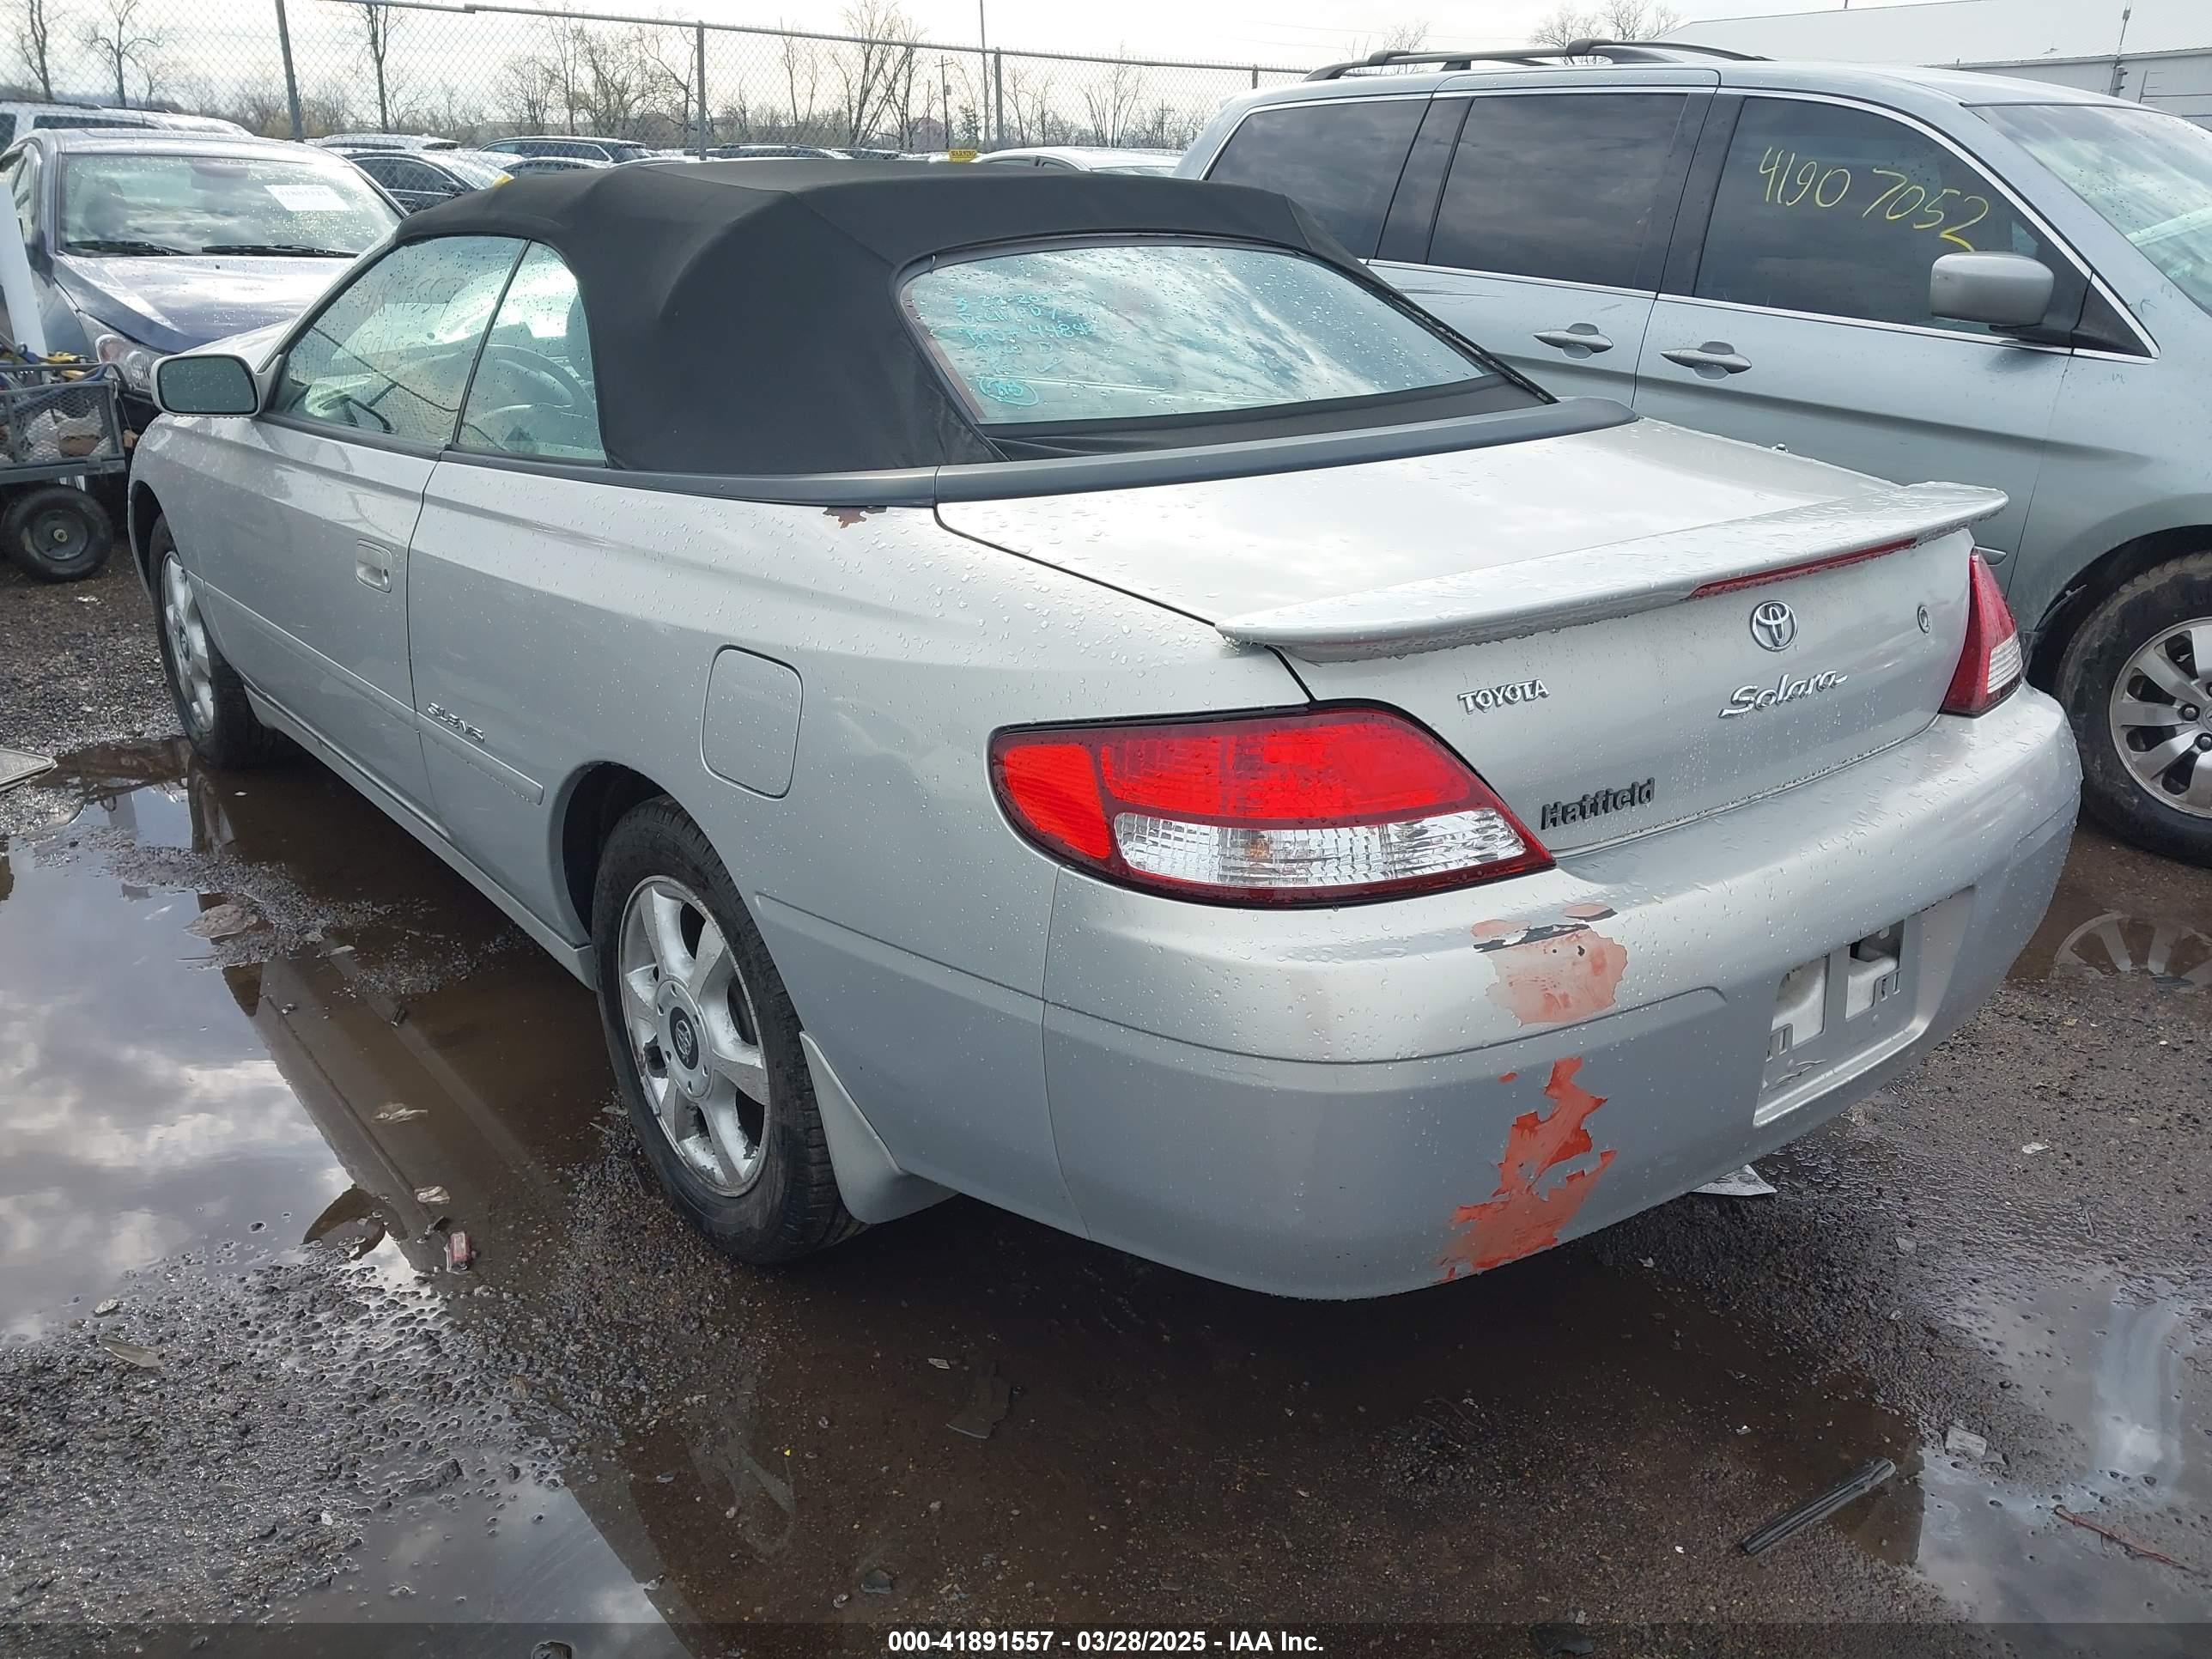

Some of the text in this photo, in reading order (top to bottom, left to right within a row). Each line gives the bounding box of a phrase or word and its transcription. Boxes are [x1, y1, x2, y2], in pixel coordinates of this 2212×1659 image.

[1759, 146, 1990, 253] 4190 7052
[1458, 678, 1549, 714] TOYOTA
[1718, 669, 1848, 718] Solara
[1540, 777, 1656, 830] Hatfield
